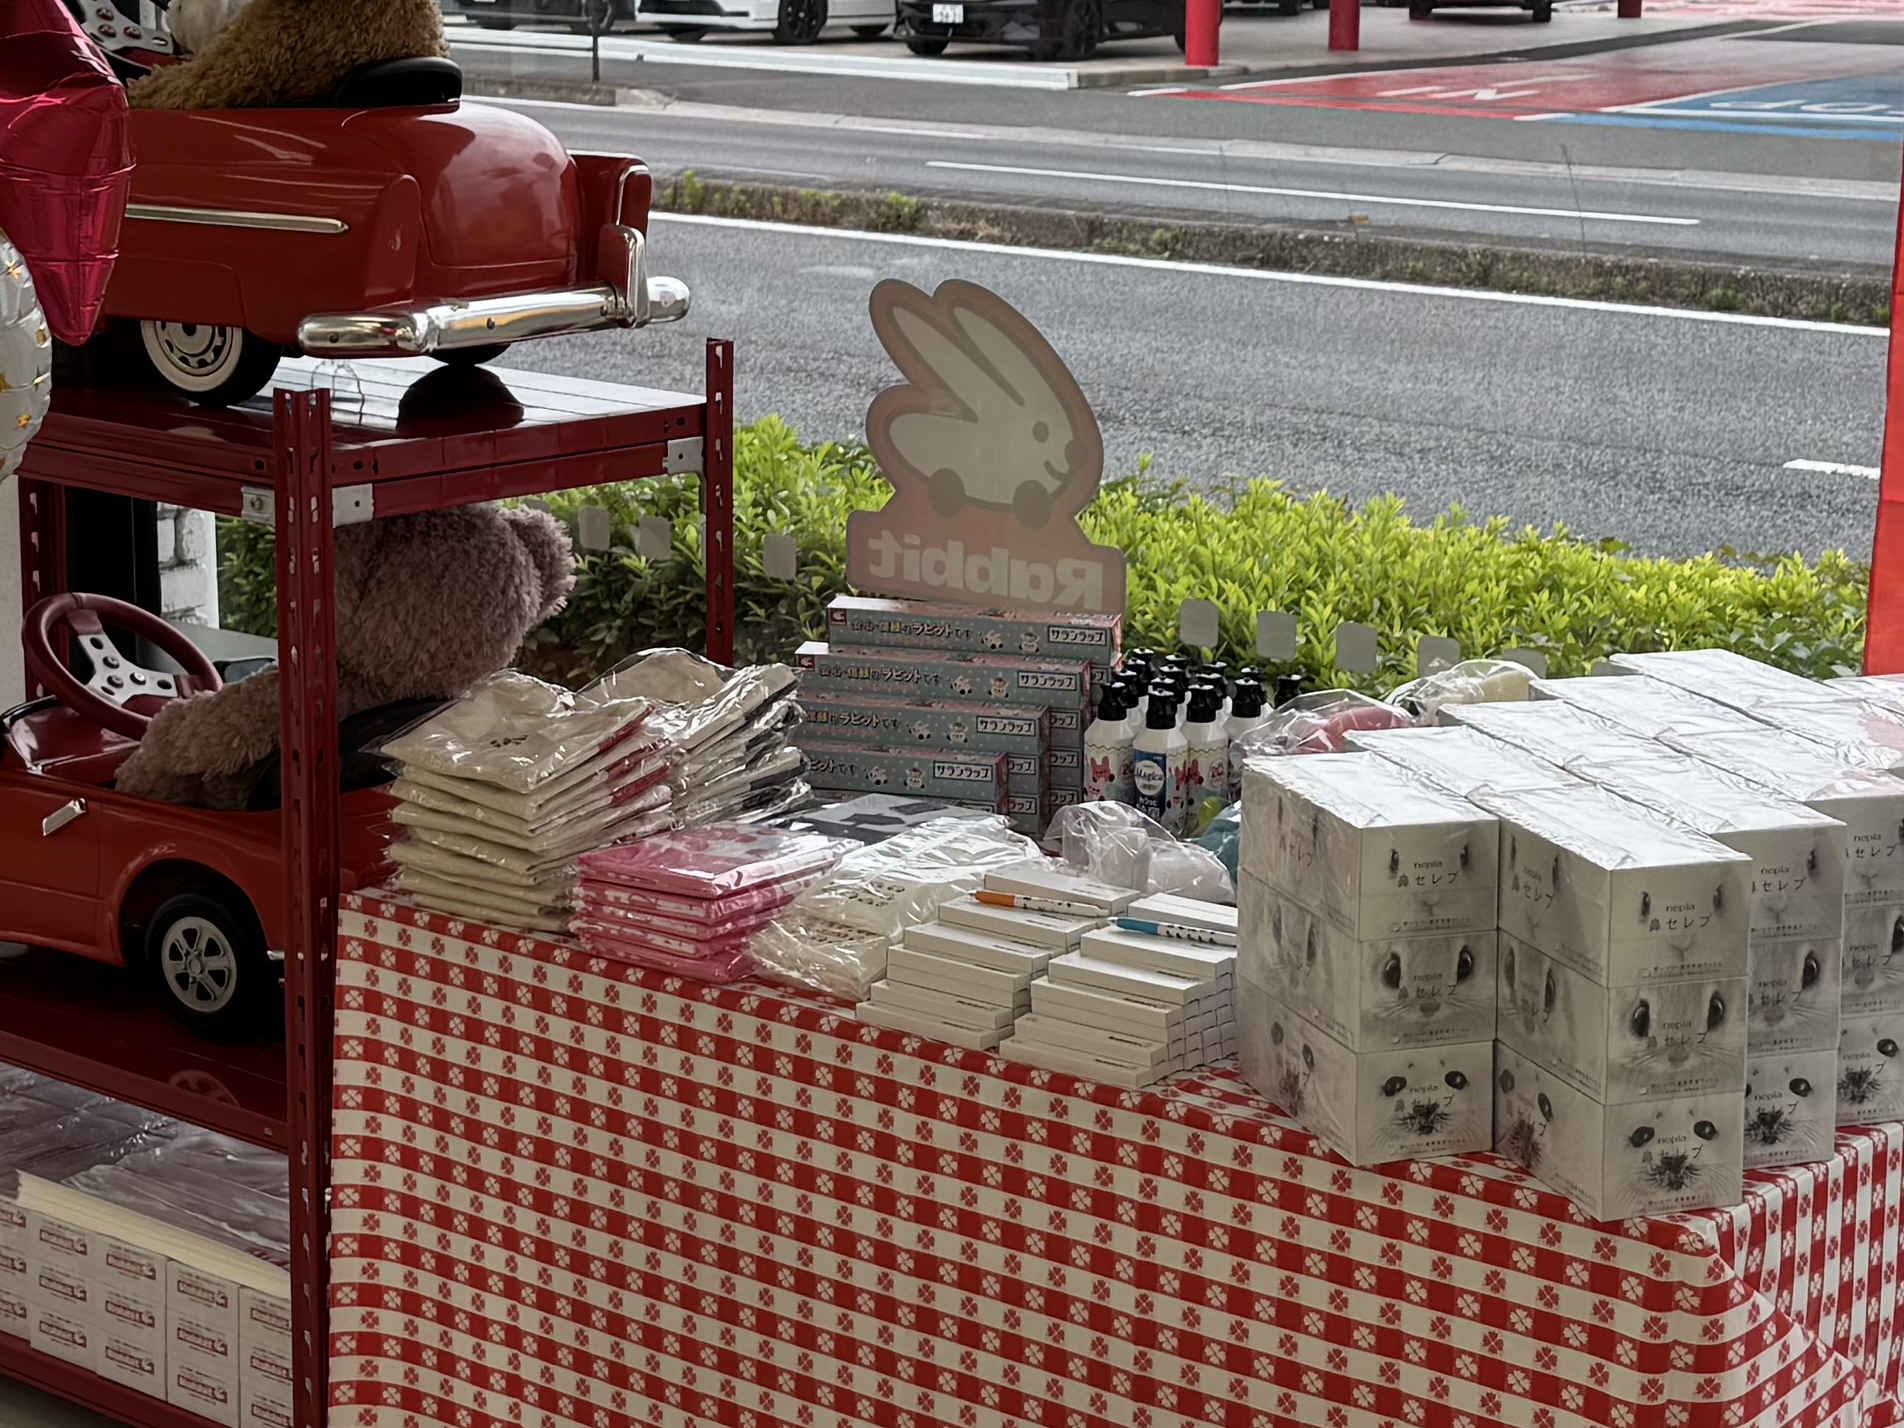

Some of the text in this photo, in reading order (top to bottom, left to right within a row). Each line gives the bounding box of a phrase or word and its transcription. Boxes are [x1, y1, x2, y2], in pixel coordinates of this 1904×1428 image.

[1845, 843, 1898, 860] セレブ
[1751, 877, 1807, 893] セレブ
[1648, 913, 1714, 932] 鼻セレブ
